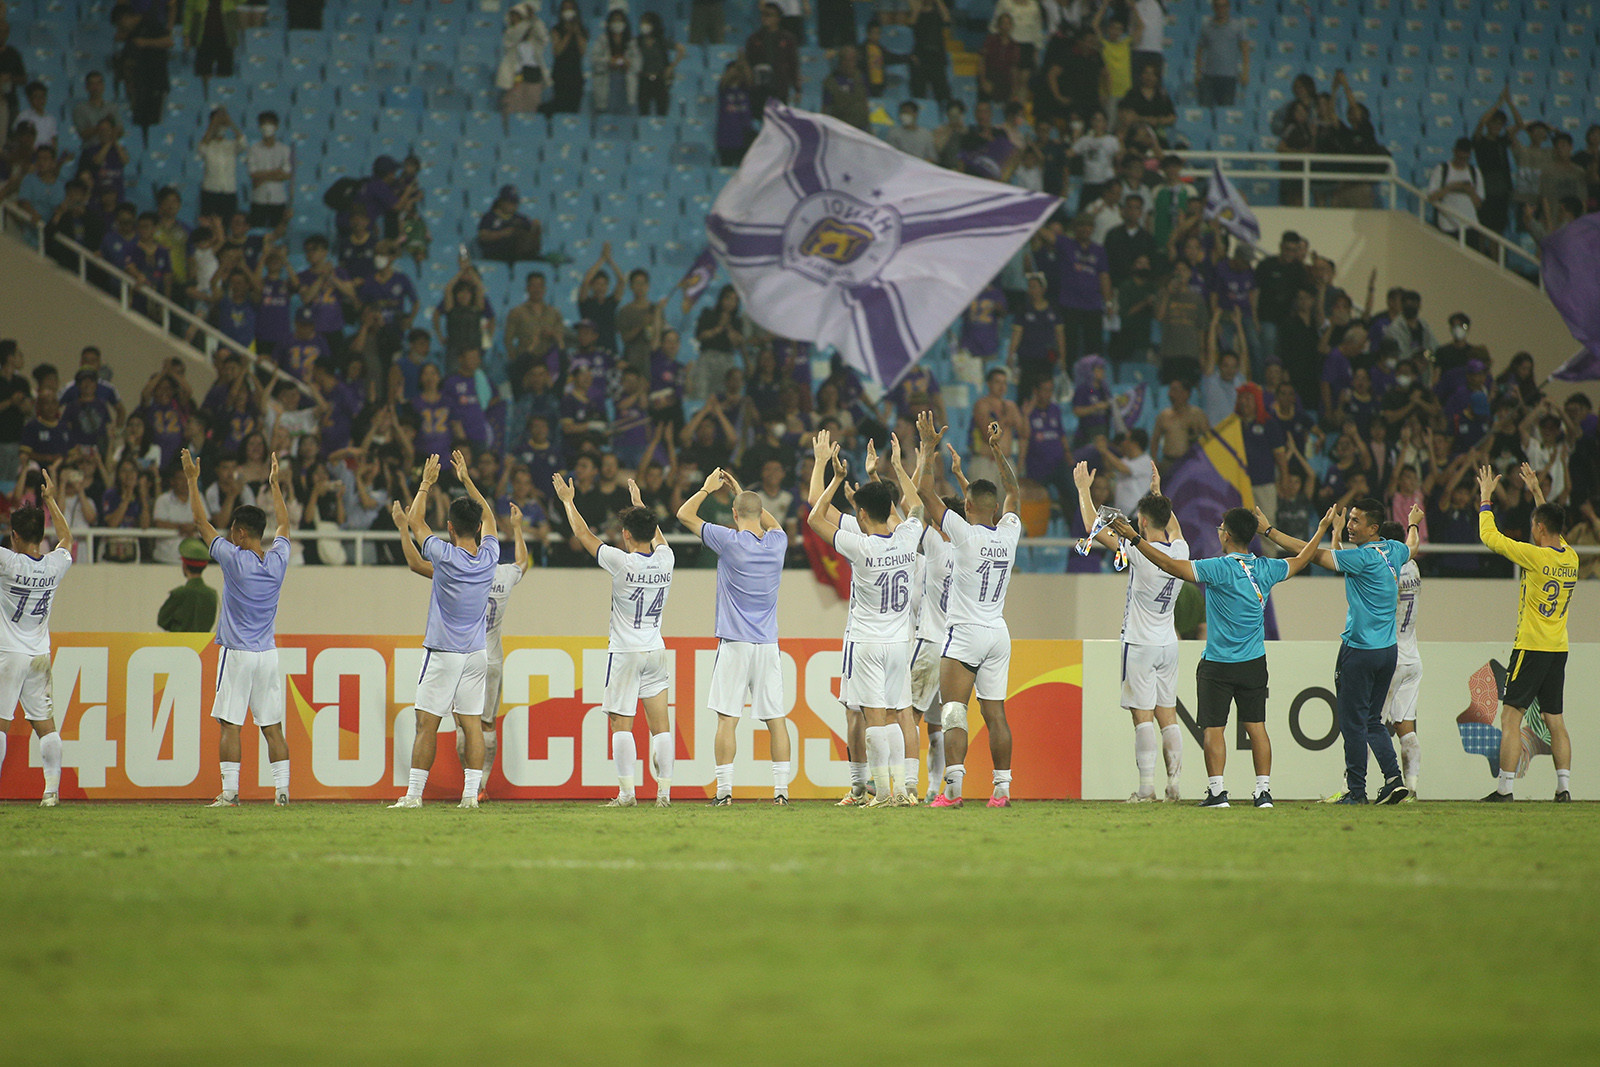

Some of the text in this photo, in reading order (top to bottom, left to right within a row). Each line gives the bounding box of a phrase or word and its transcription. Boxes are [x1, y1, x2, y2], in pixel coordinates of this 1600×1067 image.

[154, 409, 180, 433] 12
[421, 407, 448, 433] 12
[865, 552, 915, 567] N.T.CHUNG
[980, 547, 1008, 557] CAION
[626, 572, 671, 584] N.H.LONG
[874, 570, 908, 613] 16
[976, 560, 1008, 602] 17
[1154, 577, 1176, 614] 4
[10, 586, 52, 624] 74
[629, 586, 665, 629] 14
[1539, 580, 1576, 618] 37
[28, 646, 201, 788] 40
